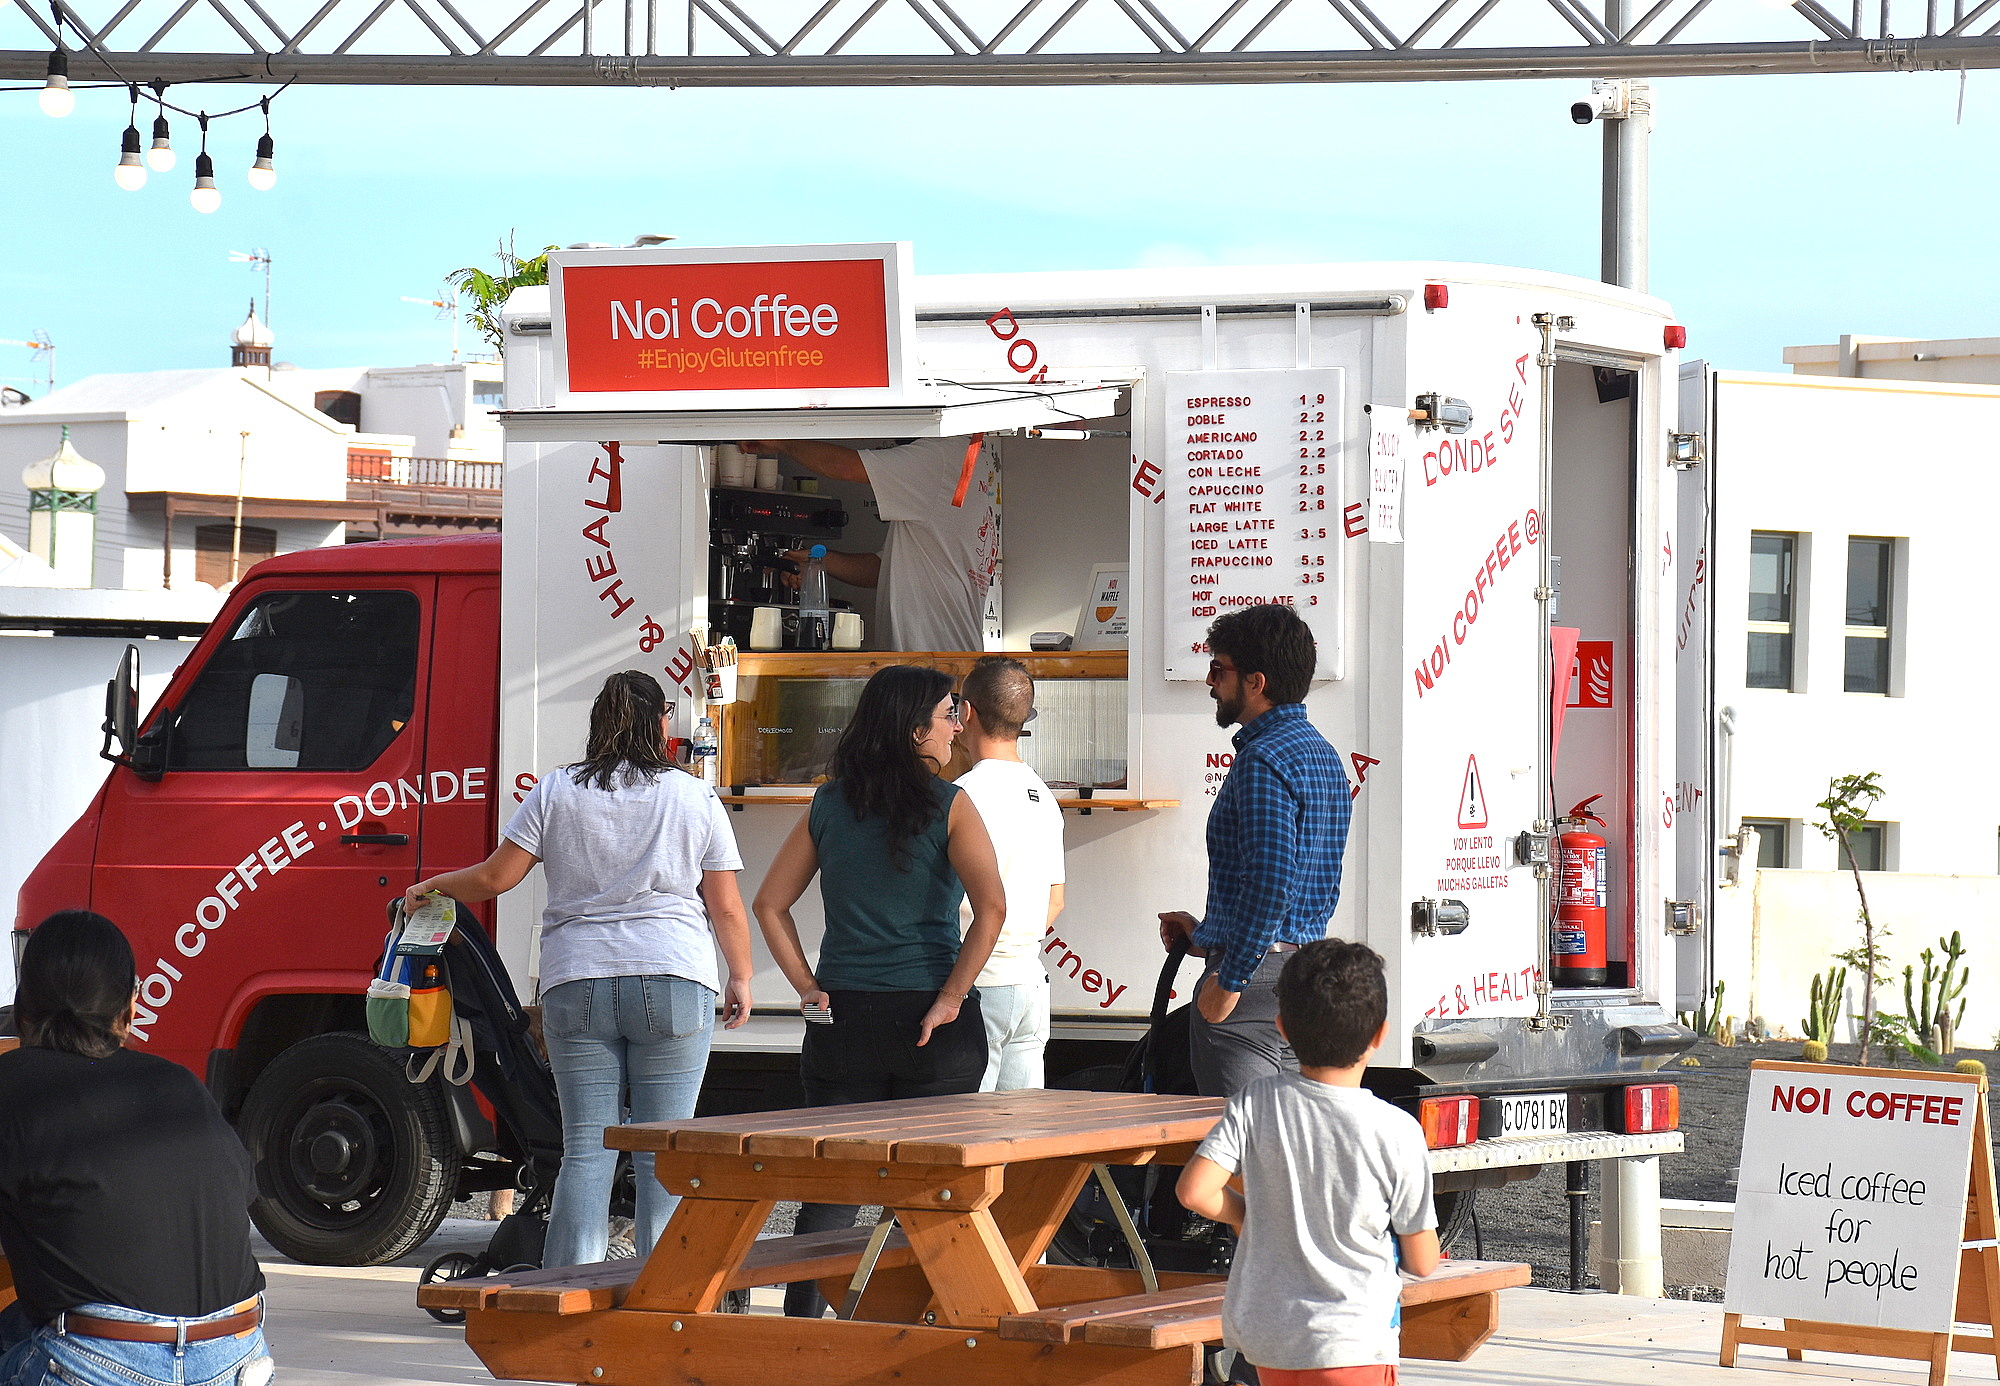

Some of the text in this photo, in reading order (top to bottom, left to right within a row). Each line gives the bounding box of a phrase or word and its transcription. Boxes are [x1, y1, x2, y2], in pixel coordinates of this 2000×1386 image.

[610, 294, 839, 340] Noi Coffee
[637, 345, 824, 373] #EnjoyGlutenfree
[1187, 394, 1325, 408] ESPRESSO 1.9
[1187, 412, 1325, 426] DOBLE 2.2
[1187, 430, 1325, 444] AMERICANO 2.2
[1187, 447, 1326, 461] CORTADO 2.2
[1423, 431, 1497, 486] DONDE
[1188, 464, 1326, 479] CON LECHE 2.5
[1188, 483, 1325, 496] CAPUCCINO 2.8
[1189, 499, 1325, 514] FLAT WHITE 2.8
[1190, 519, 1275, 533] LARGE LATTE
[1301, 528, 1327, 539] 3.5
[1191, 538, 1268, 550] ICED LATTE
[1191, 555, 1325, 567] FRAPUCCINO 5.5
[1190, 571, 1325, 585] CHAI 3.5
[1101, 591, 1120, 601] WAFFLE
[1192, 591, 1318, 606] HOT CHOCOLATE 3
[1191, 606, 1217, 617] ICED
[1415, 635, 1450, 699] NOI
[1454, 519, 1521, 646] COFFEE
[1453, 836, 1493, 850] VOY LENTO
[1446, 855, 1501, 873] PORQUE LLEVO
[1437, 875, 1508, 892] MUCHAS GALLETAS
[130, 958, 182, 1042] NOI
[175, 821, 314, 957] COFFEE
[333, 767, 486, 830] DONDE
[1045, 925, 1127, 1009] rney
[1771, 1085, 1963, 1126] NOI COFFEE
[1779, 1162, 1926, 1206] Iced coffee
[1825, 1208, 1872, 1244] for
[1763, 1240, 1918, 1301] hot people
